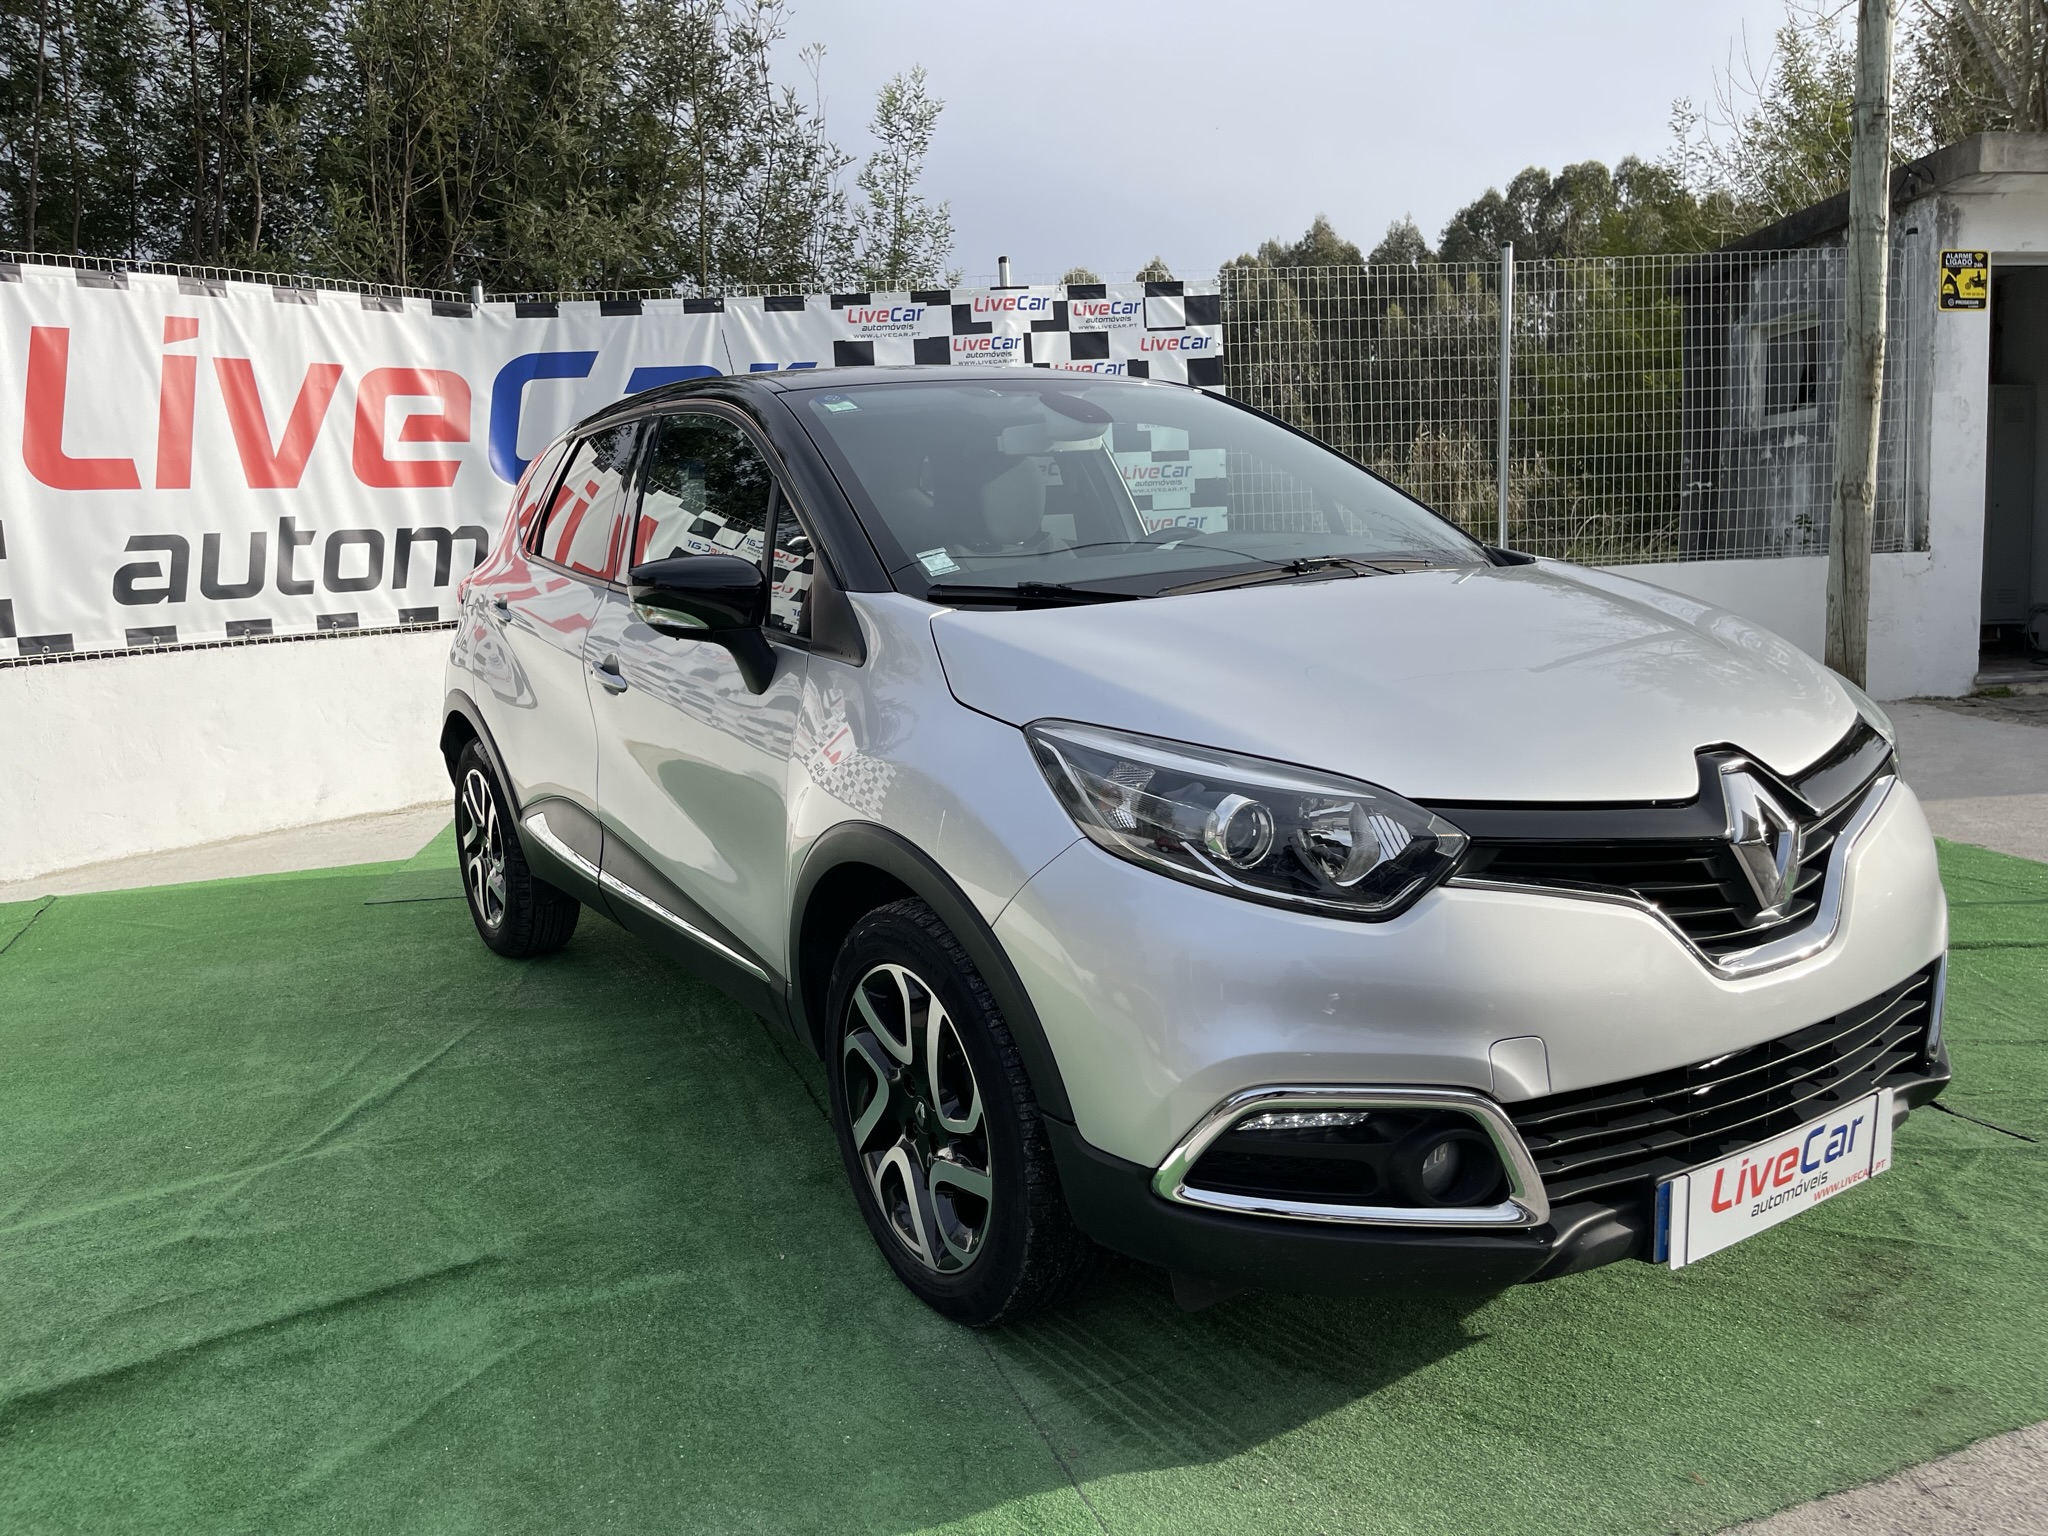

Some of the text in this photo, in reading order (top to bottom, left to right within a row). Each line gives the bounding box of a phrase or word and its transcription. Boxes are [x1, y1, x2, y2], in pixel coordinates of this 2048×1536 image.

[974, 295, 1050, 312] LiveCar
[1073, 301, 1141, 317] LiveCar
[847, 307, 925, 324] LiveCar
[1085, 316, 1132, 324] automóveis
[861, 322, 914, 332] automóveis
[953, 336, 1022, 351] LiveCar
[1140, 336, 1212, 352] LiveCar
[965, 351, 1013, 359] automóveis
[1123, 464, 1193, 480] LiveCar
[1145, 515, 1208, 531] iveCar
[1711, 1115, 1864, 1213] LiveCar
[1751, 1171, 1829, 1217] automóveis
